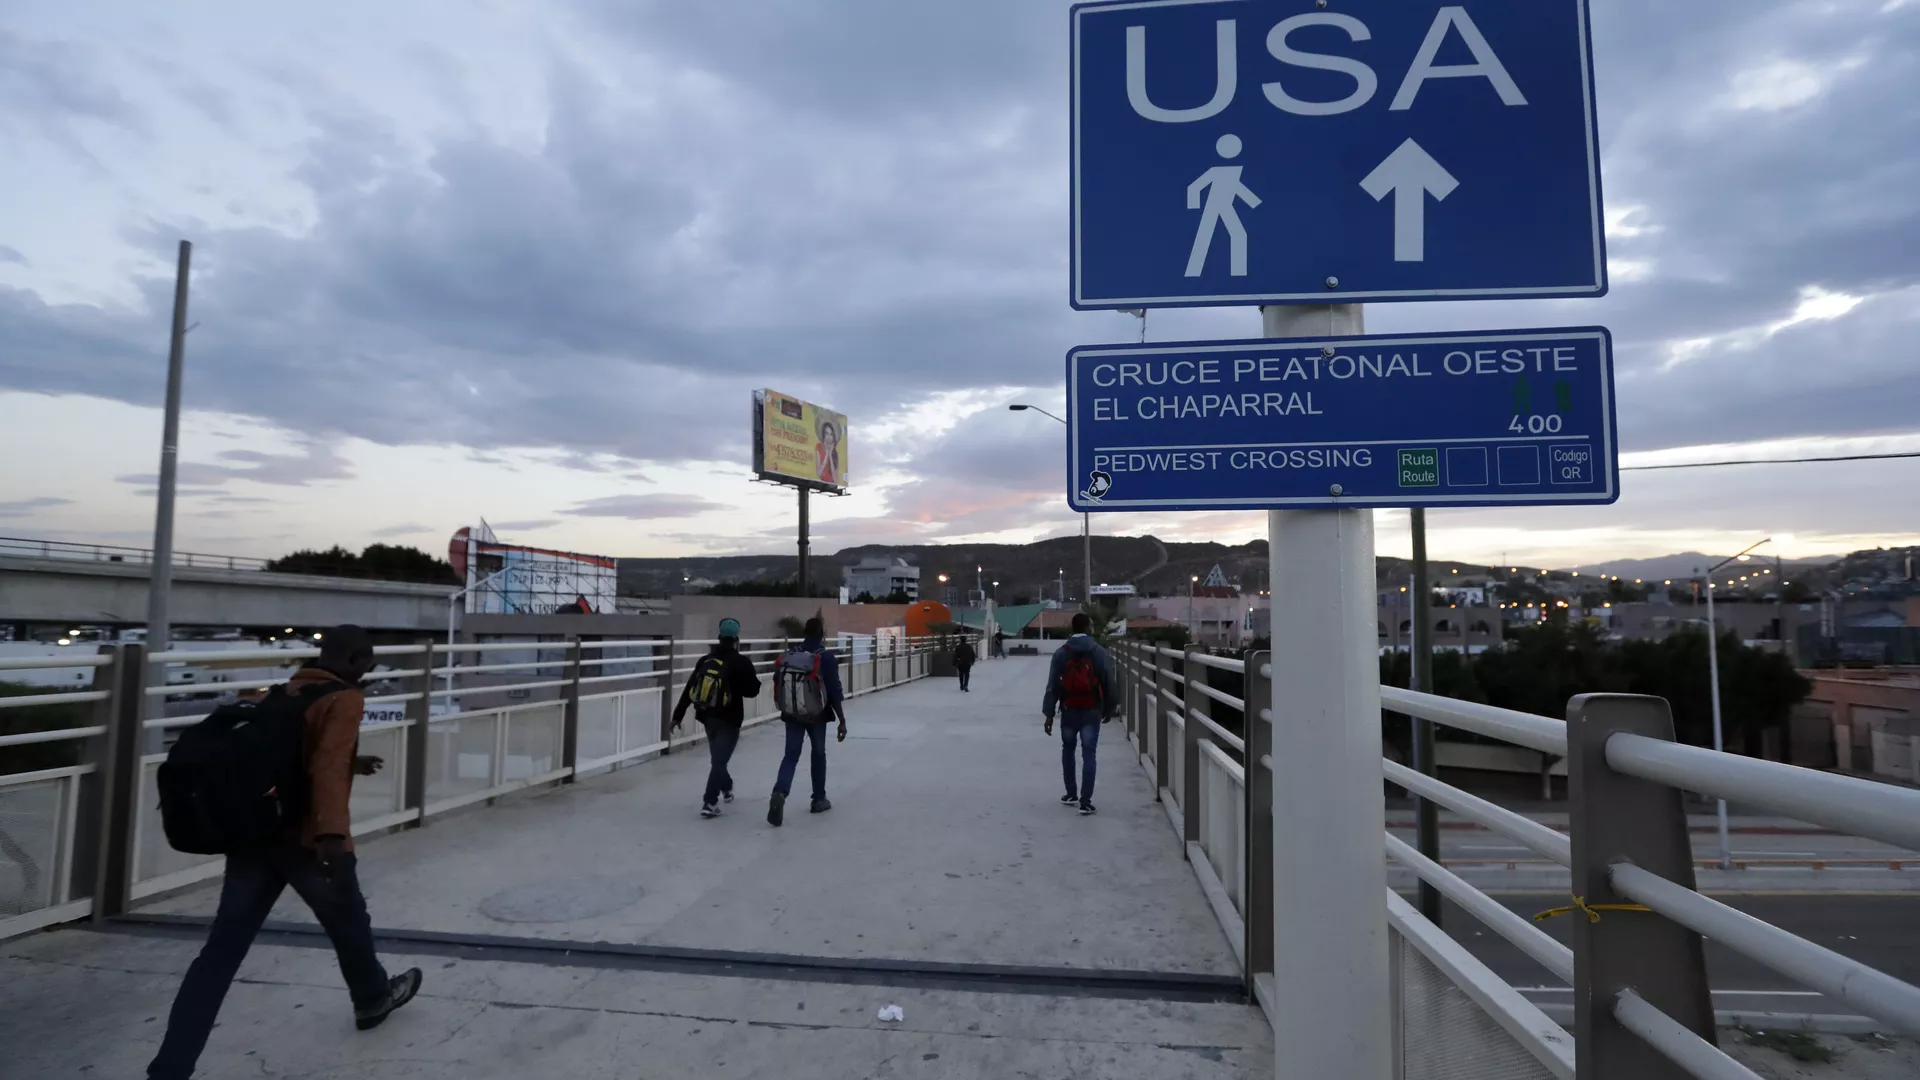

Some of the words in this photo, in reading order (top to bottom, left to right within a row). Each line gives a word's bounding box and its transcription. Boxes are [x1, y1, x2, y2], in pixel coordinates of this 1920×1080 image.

[1126, 6, 1528, 122] USA
[1092, 360, 1220, 387] CRUCE
[1234, 353, 1432, 382] PEATONAL
[1443, 346, 1578, 374] OESTE
[1094, 398, 1129, 421] EL
[1137, 391, 1323, 419] CHAPARRAL
[1508, 414, 1562, 433] 400
[1094, 452, 1222, 472] PEDWEST
[1231, 449, 1373, 470] CROSSING
[1402, 453, 1434, 466] Ruta
[1554, 449, 1588, 464] Codigo
[1403, 470, 1435, 482] Route
[1561, 466, 1582, 479] QR
